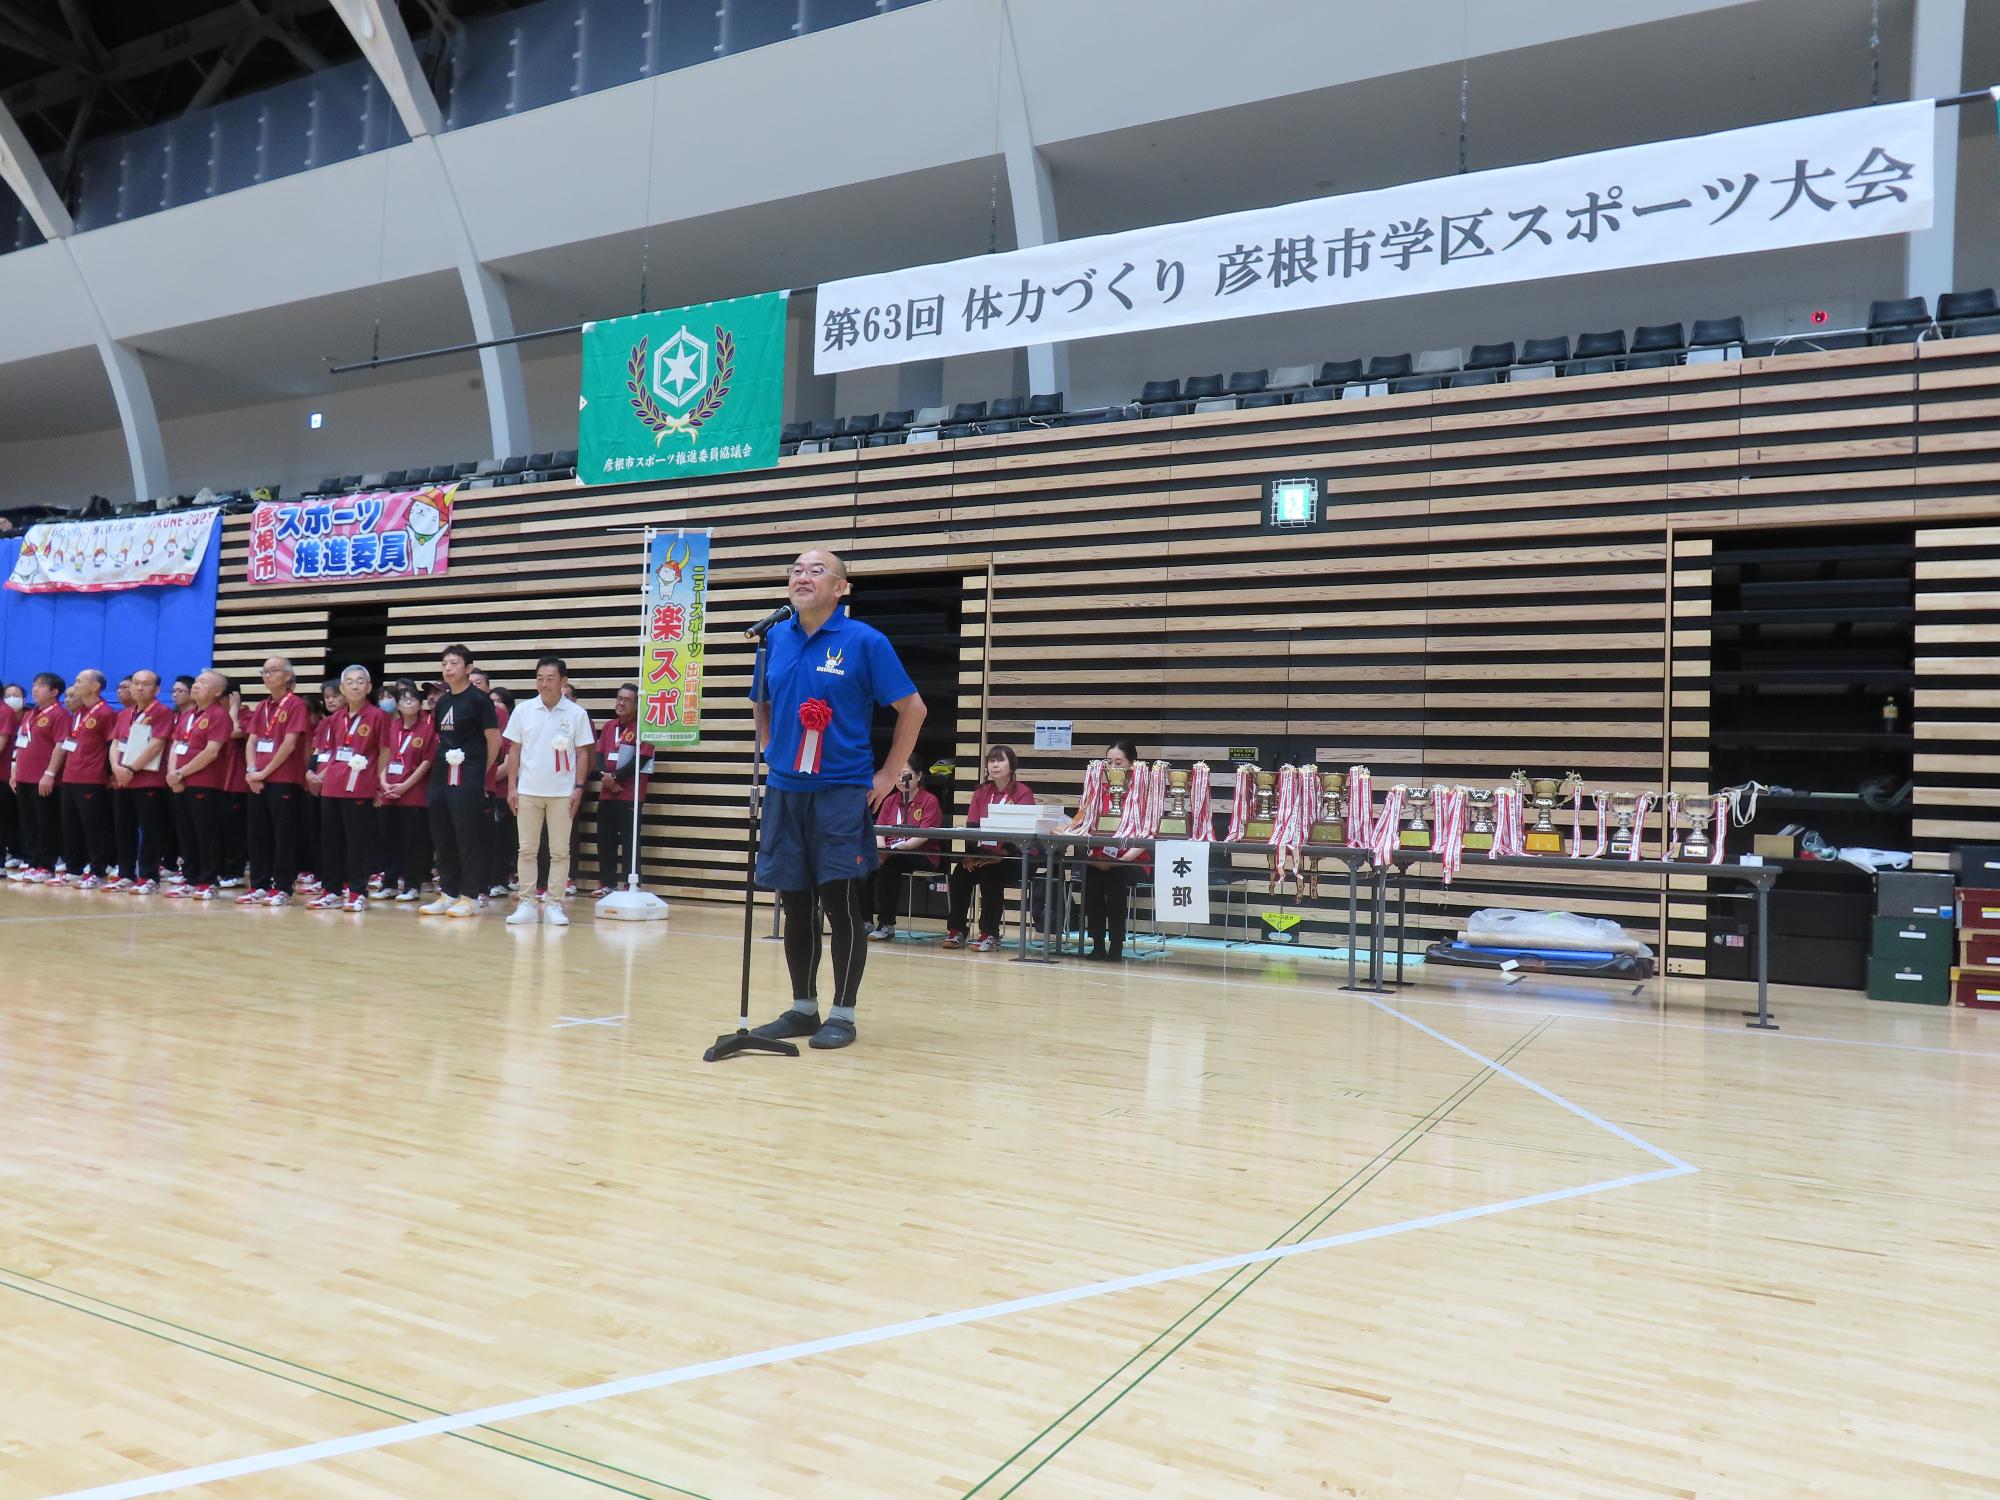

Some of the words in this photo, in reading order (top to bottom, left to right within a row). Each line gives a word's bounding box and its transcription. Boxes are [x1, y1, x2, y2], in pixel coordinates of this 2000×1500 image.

[822, 294, 945, 353] 第63回
[961, 258, 1185, 332] 体力づくり
[1214, 147, 1914, 297] 彦根市学区スポーツ大会
[603, 443, 753, 472] 彦根市スポーツ推進委員協議会
[255, 506, 277, 580] 彦根市
[276, 499, 384, 538] スポーツ
[294, 531, 409, 578] 推進委員
[688, 566, 705, 658] ニュースポーツ
[646, 605, 684, 726] 楽スポ
[682, 662, 701, 727] 出前講座
[1172, 856, 1193, 907] 本部
